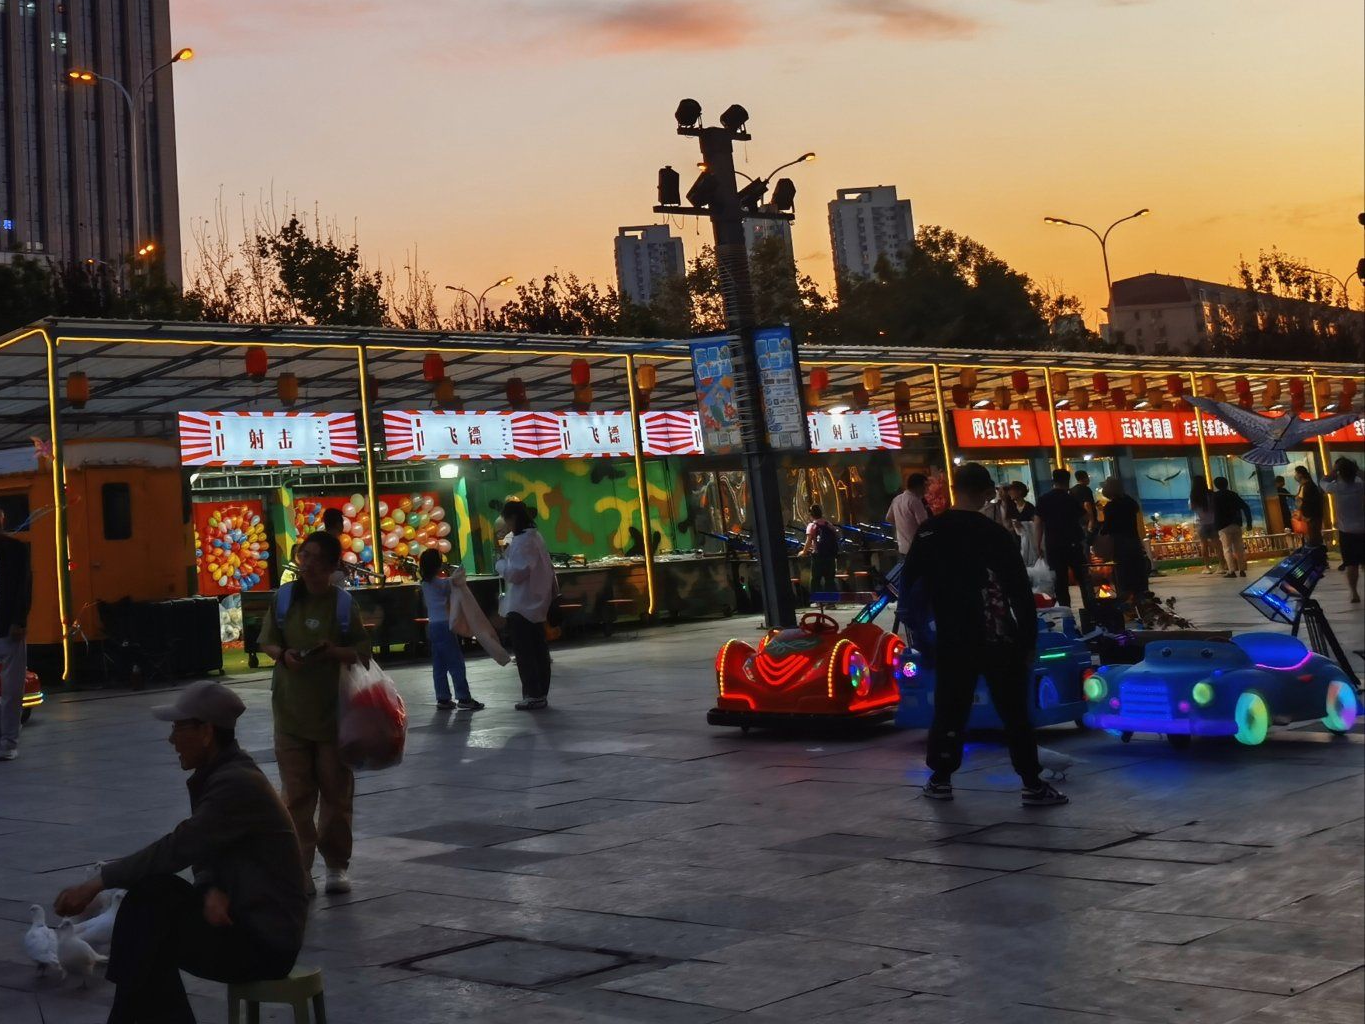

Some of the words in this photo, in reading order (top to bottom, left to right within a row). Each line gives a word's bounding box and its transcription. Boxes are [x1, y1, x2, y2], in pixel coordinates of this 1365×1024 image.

[444, 425, 482, 445] 飞镖
[587, 425, 621, 445] 飞镖
[832, 422, 860, 441] 射击
[971, 417, 1022, 440] 网红打卡
[1120, 417, 1174, 439] 运动套圈圈
[248, 428, 293, 450] 射击
